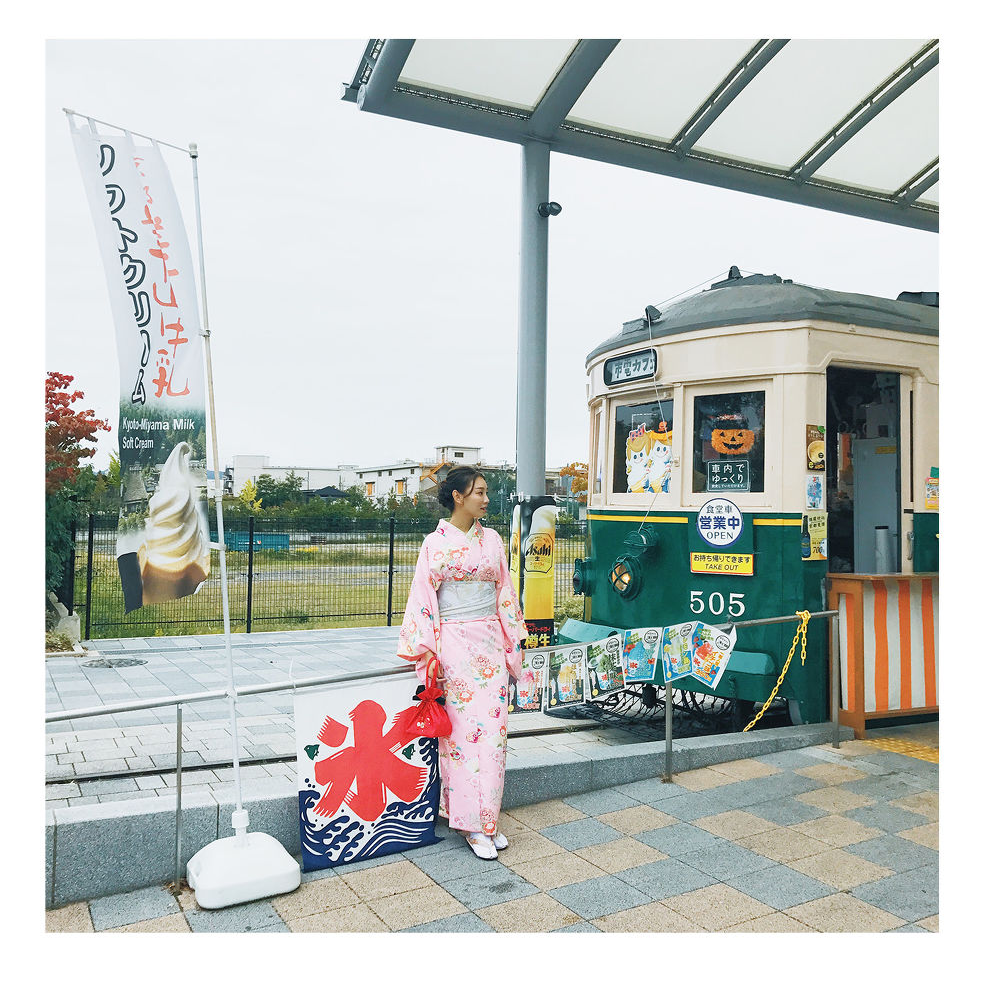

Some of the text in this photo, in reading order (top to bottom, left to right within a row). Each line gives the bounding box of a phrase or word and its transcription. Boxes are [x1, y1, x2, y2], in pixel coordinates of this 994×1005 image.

[123, 417, 195, 431] Kyoto-Miyama Milk
[122, 437, 154, 450] Soft Cream
[711, 463, 745, 473] 車内で
[711, 474, 744, 484] ゆっくり
[706, 505, 733, 514] 食堂車
[700, 516, 740, 530] 営業中
[706, 531, 734, 539] OPEN
[526, 544, 551, 556] Asahi
[694, 554, 750, 563] お持ち帰りできます
[690, 591, 746, 616] 505
[313, 699, 428, 822] 氷
